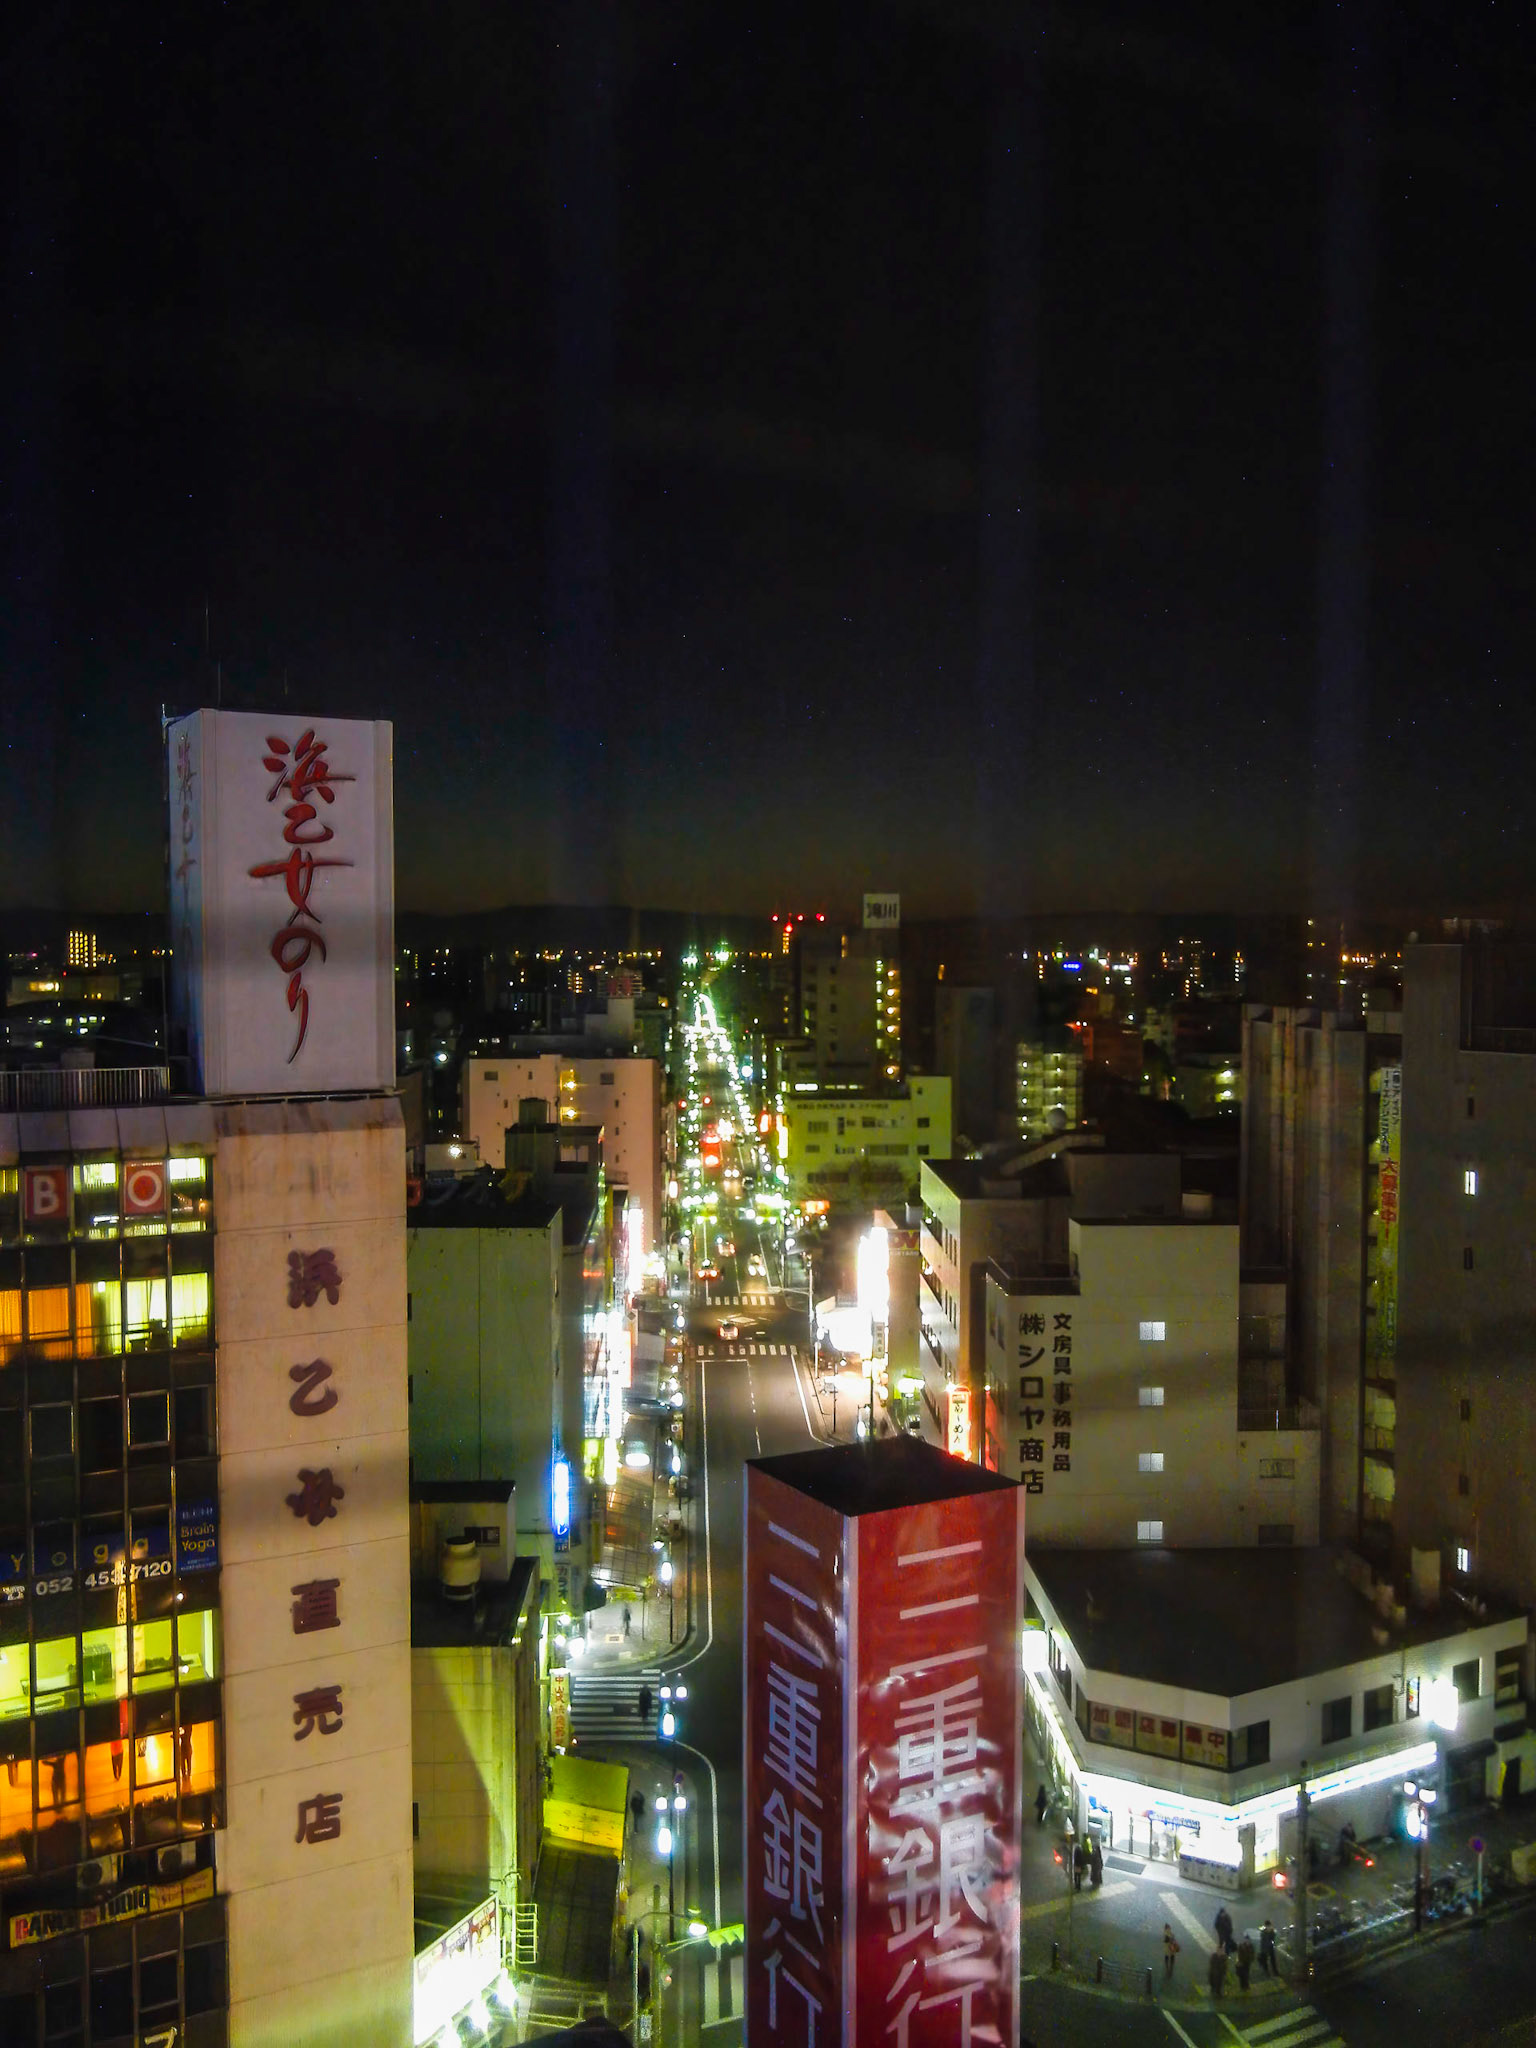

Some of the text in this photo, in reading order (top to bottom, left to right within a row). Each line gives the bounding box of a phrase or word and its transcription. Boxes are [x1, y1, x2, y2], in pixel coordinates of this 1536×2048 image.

[247, 728, 356, 1064] 浜乙女のり
[1052, 1312, 1072, 1472] 文房具事務用品
[36, 1576, 73, 1596] 052
[181, 1538, 216, 1553] Yoga
